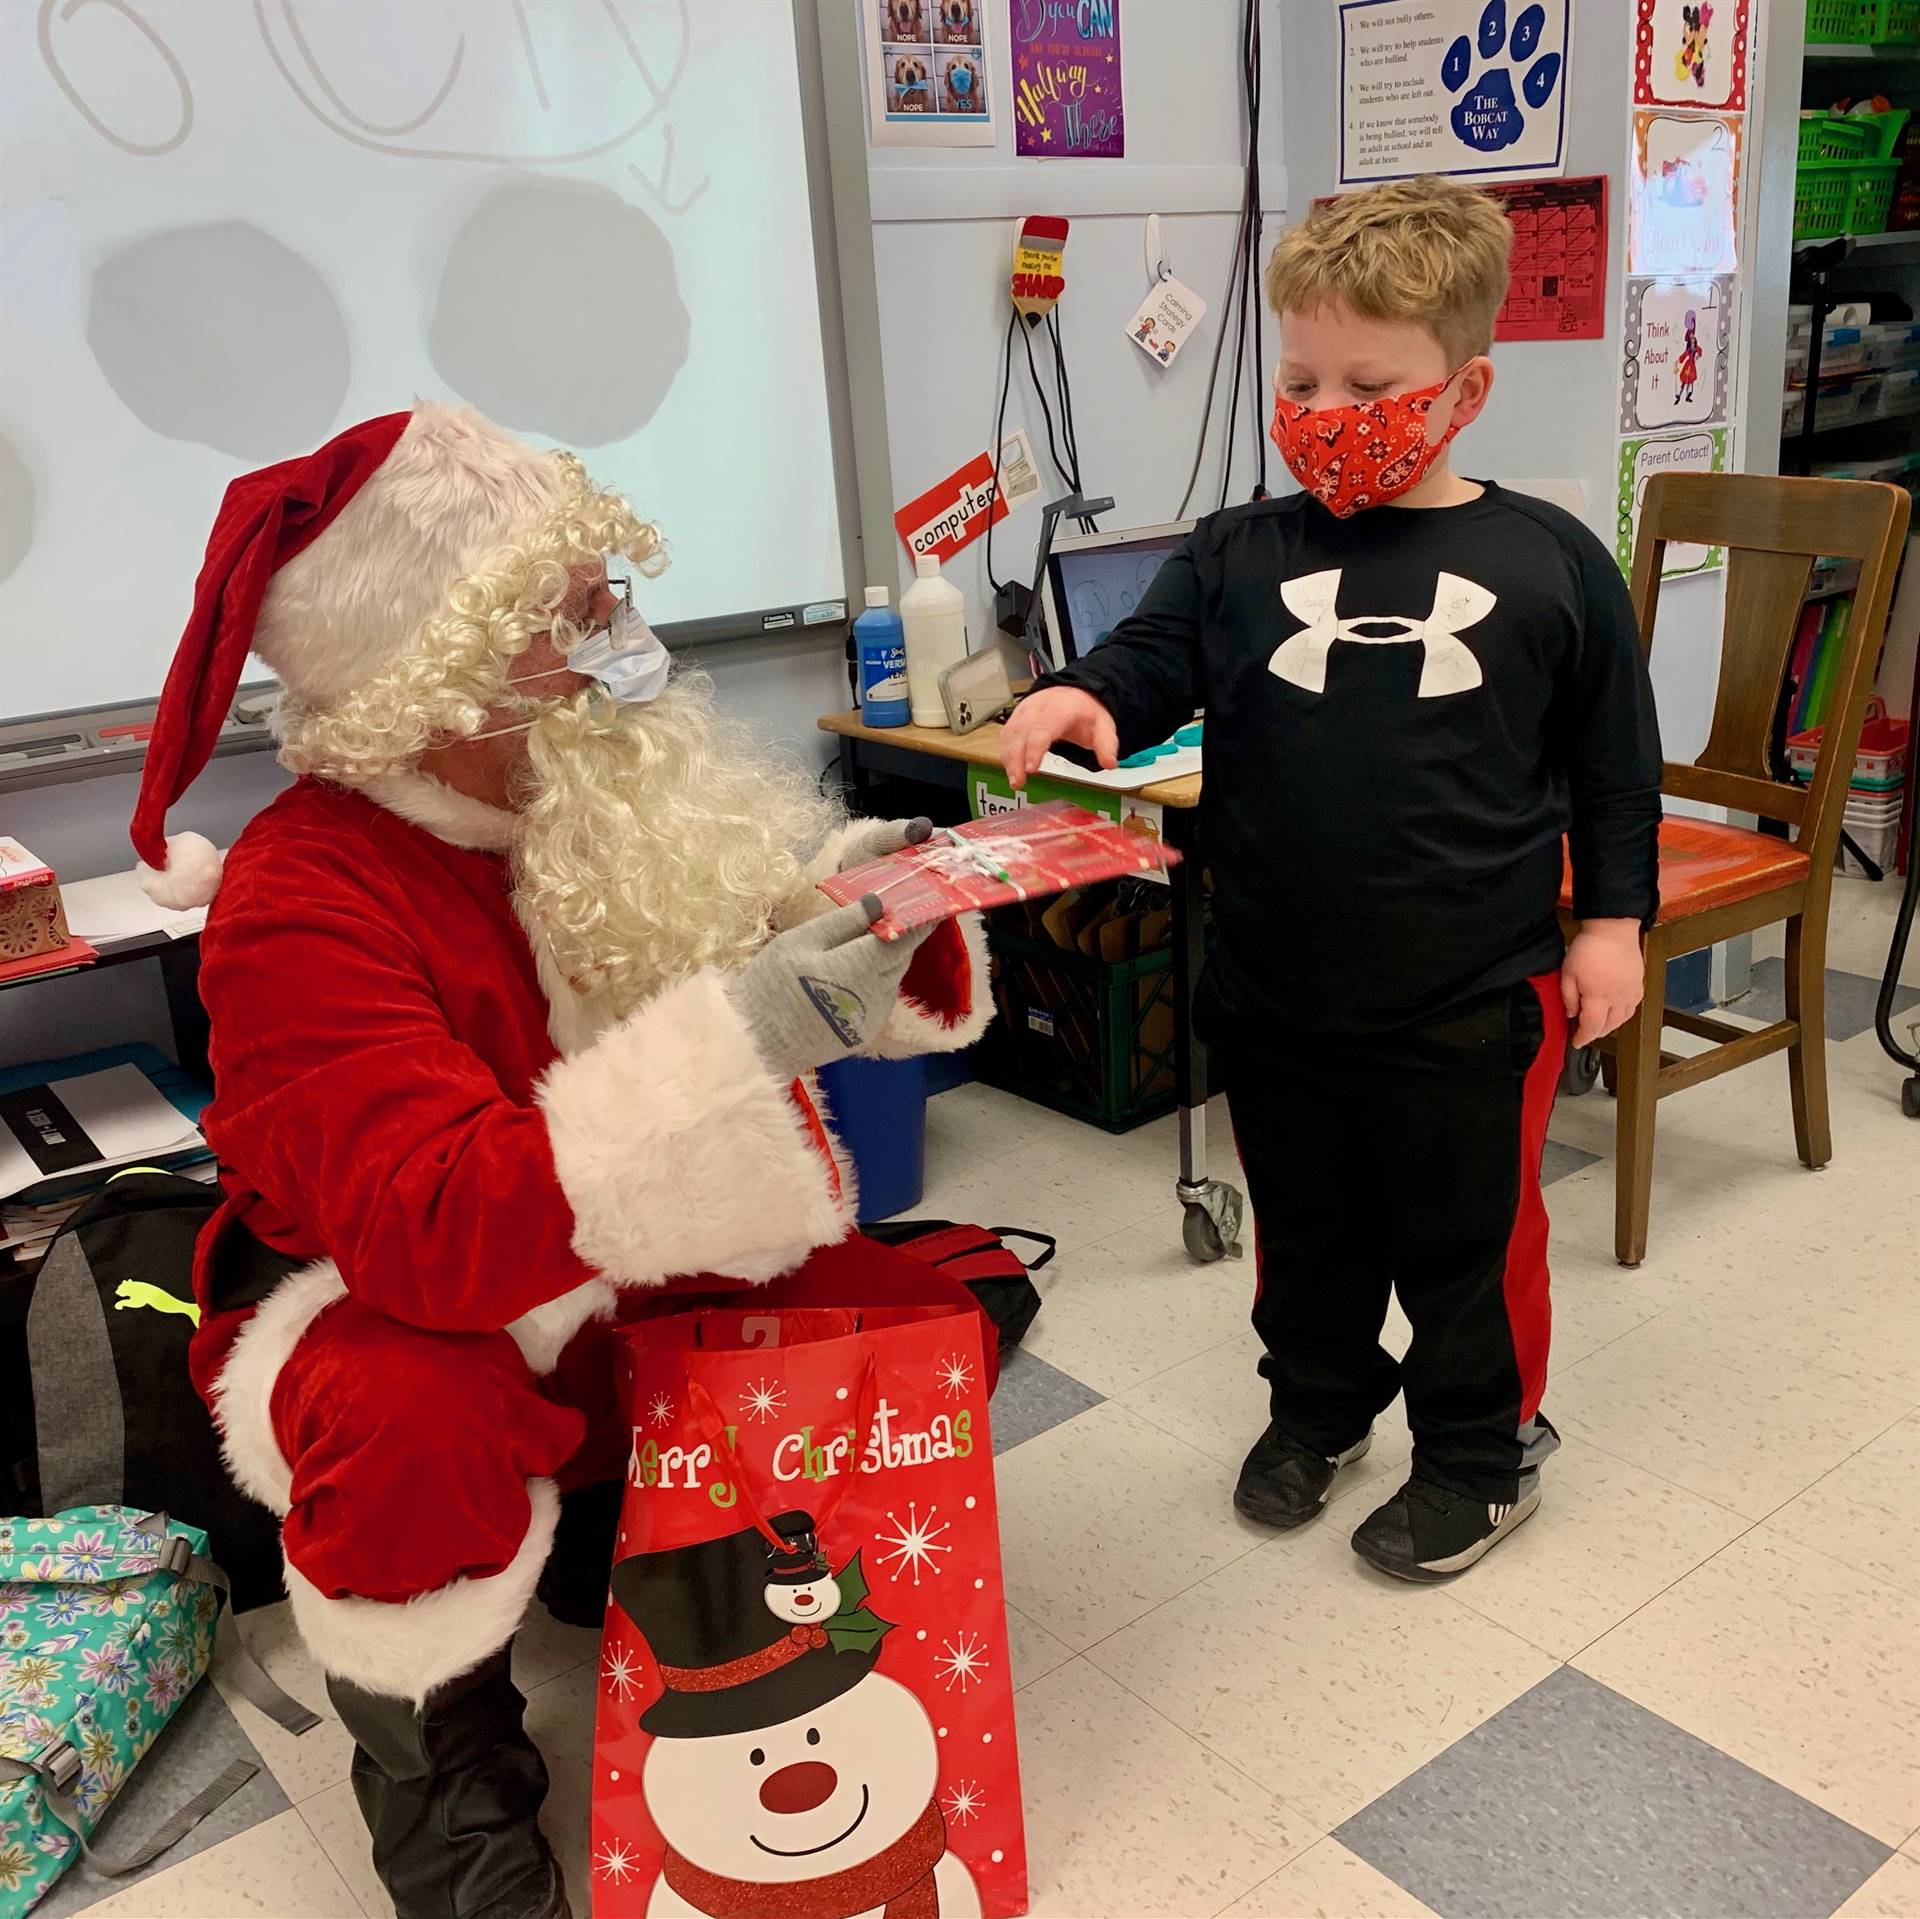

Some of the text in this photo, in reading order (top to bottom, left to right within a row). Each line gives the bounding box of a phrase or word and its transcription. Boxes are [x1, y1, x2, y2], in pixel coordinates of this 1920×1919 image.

[1048, 1, 1075, 37] you
[1077, 0, 1114, 40] CAN
[1360, 20, 1370, 29] We
[1372, 18, 1383, 27] will
[1385, 18, 1394, 26] not
[1396, 14, 1412, 24] bully
[1488, 21, 1497, 37] 2
[1521, 25, 1531, 42] 3
[897, 33, 917, 42] NOPE
[948, 34, 968, 43] NOPE
[1360, 46, 1370, 54] We
[1372, 44, 1383, 53] will
[1385, 44, 1393, 52] try
[1403, 40, 1417, 50] help
[1418, 36, 1444, 46] students
[1360, 58, 1372, 67] who
[1453, 56, 1459, 72] 1
[1359, 84, 1369, 92] We
[1371, 81, 1383, 90] will
[1384, 81, 1393, 91] try
[1402, 77, 1425, 88] include
[1536, 72, 1545, 88] 4
[1016, 60, 1087, 127] Halfway
[1359, 96, 1384, 105] students
[1385, 93, 1400, 102] who
[1411, 90, 1422, 98] left
[903, 104, 924, 112] NOPE
[955, 99, 972, 109] YES
[1473, 95, 1499, 110] THE
[1359, 120, 1366, 129] If
[1376, 119, 1393, 127] know
[1394, 117, 1406, 125] that
[1408, 113, 1438, 124] somebody
[1463, 110, 1509, 126] BOBCAT
[1366, 132, 1382, 142] being
[1409, 129, 1417, 137] we
[1419, 126, 1431, 135] will
[1432, 125, 1443, 133] tell
[1471, 125, 1500, 140] WAY
[1711, 126, 1726, 151] 2
[1367, 144, 1383, 153] adult
[1391, 141, 1411, 150] school
[1412, 140, 1424, 149] and
[1359, 157, 1374, 166] adult
[1012, 273, 1065, 299] SHARP
[1702, 286, 1717, 310] 1
[1159, 301, 1186, 329] Strategy
[1165, 293, 1192, 321] Calming
[1157, 313, 1177, 334] Cards
[1646, 322, 1670, 338] Think
[1644, 348, 1669, 365] About
[1651, 374, 1660, 390] It
[1640, 444, 1710, 467] Parent Contact!
[914, 487, 996, 553] computer
[772, 1399, 974, 1484] Christmas
